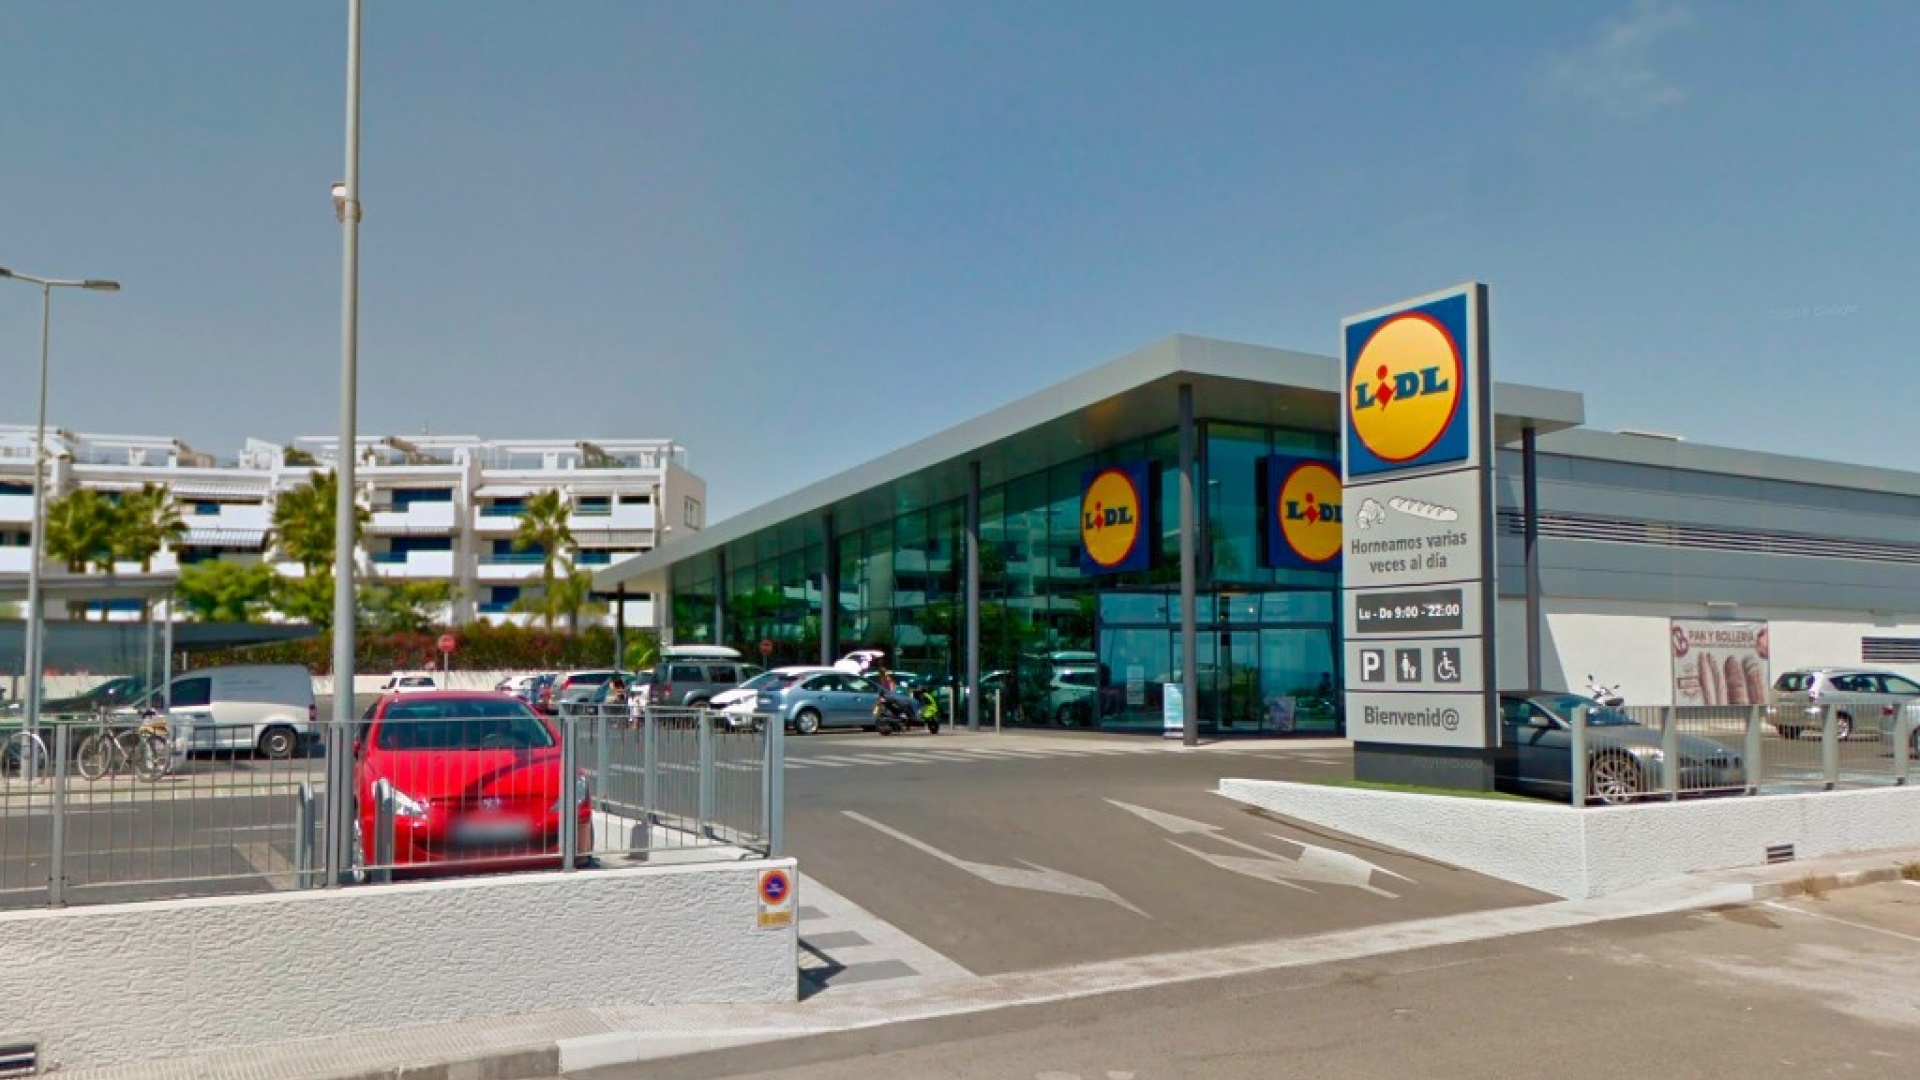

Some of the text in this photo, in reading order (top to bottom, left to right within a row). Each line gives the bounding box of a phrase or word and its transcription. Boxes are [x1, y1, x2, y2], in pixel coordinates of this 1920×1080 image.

[1351, 530, 1467, 555] Horneamos varias
[1370, 552, 1447, 573] veces al día
[1394, 606, 1418, 619] 9:00
[1427, 604, 1460, 617] 22:00
[1362, 650, 1381, 681] P
[1364, 705, 1460, 731] Bienvenid@
